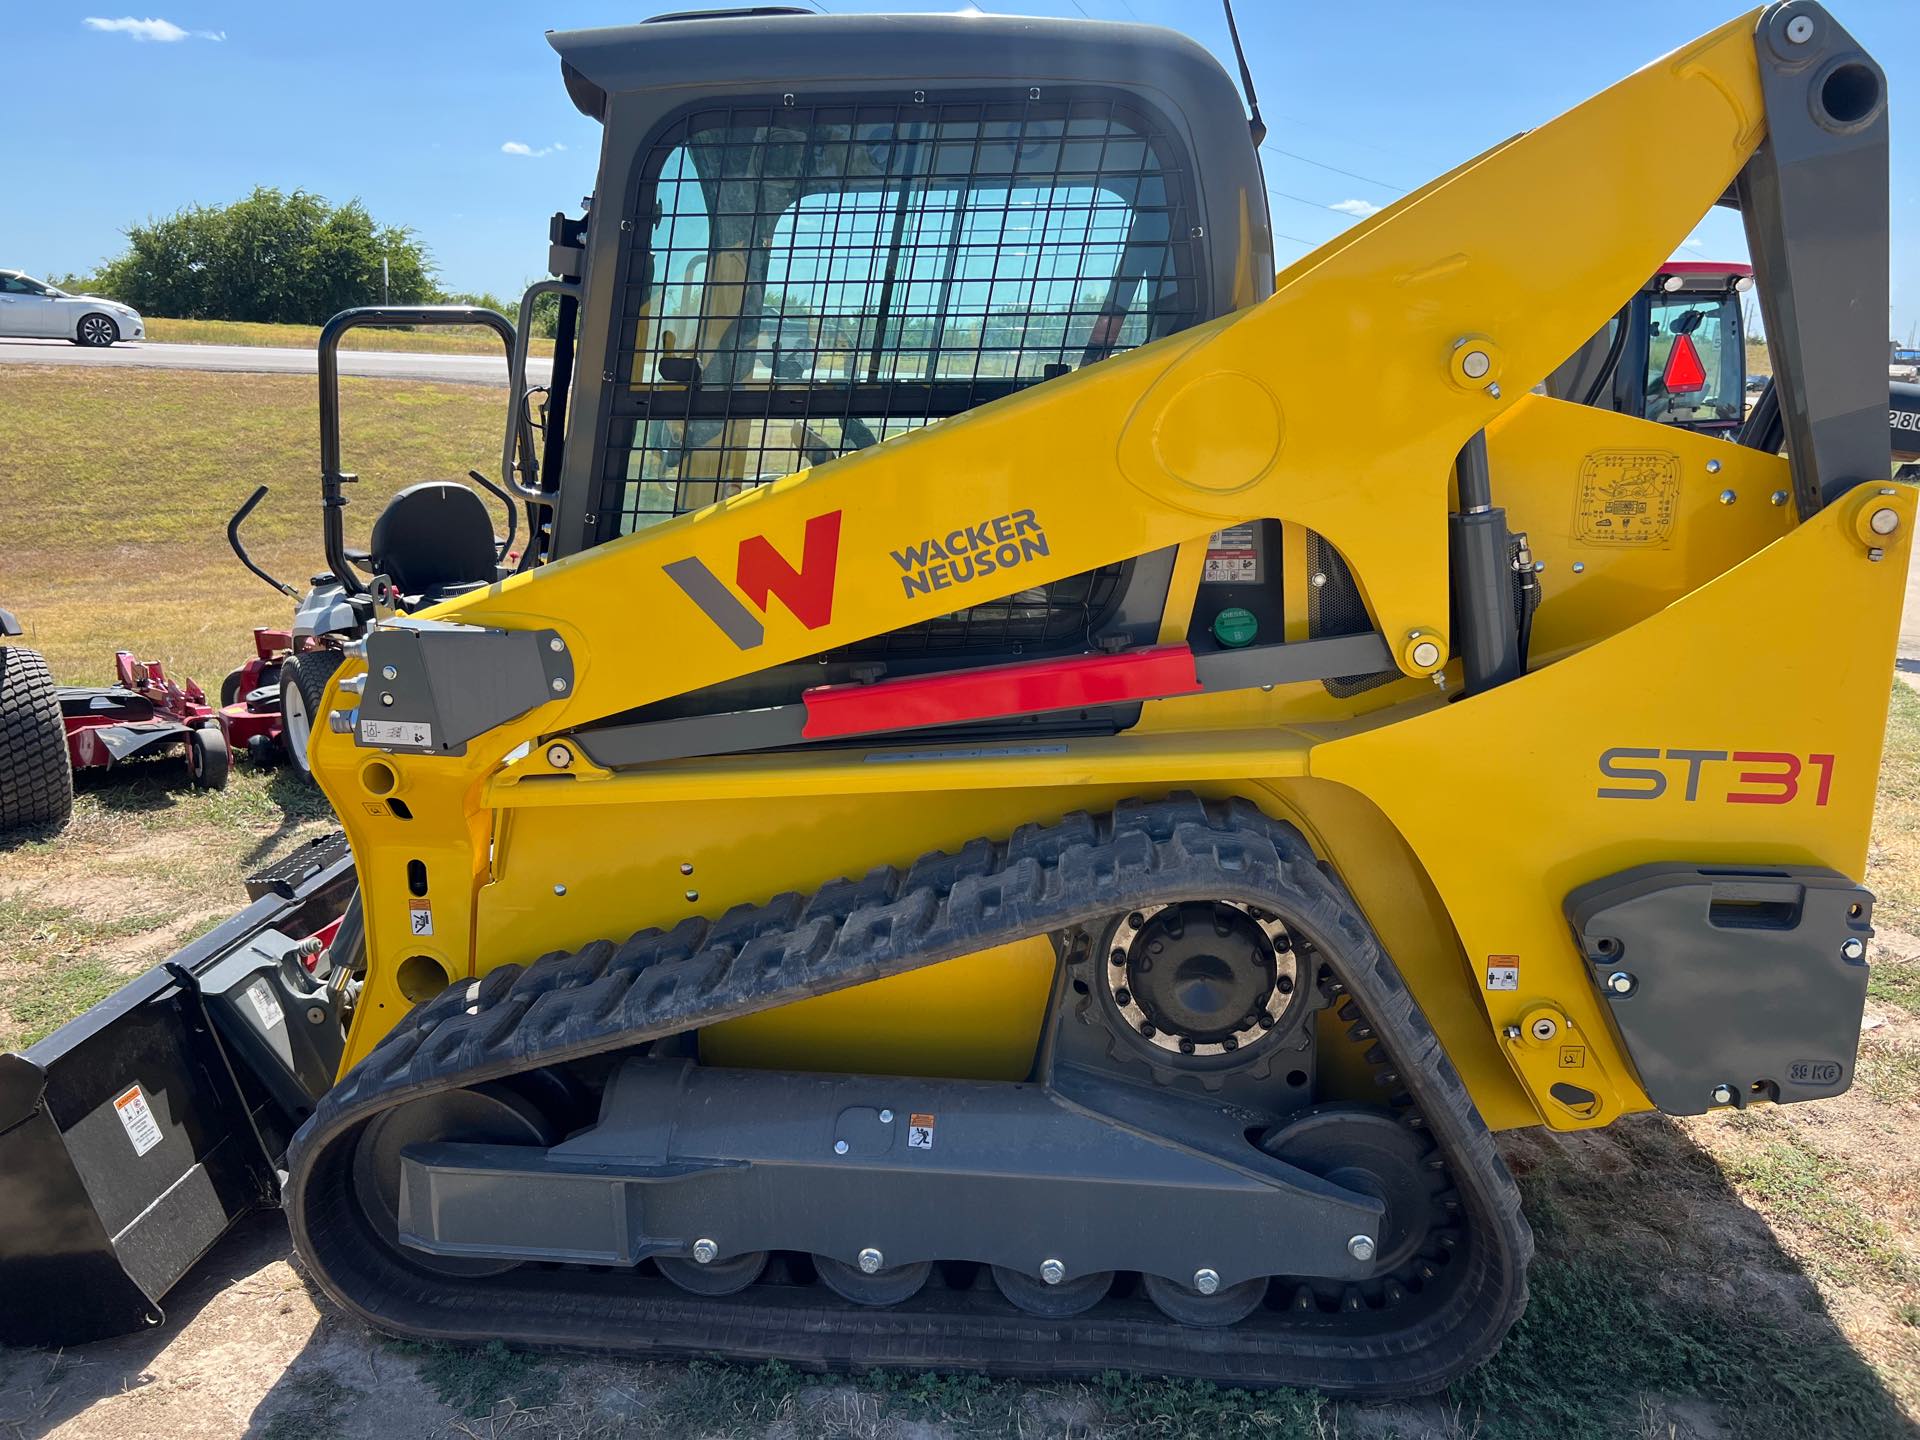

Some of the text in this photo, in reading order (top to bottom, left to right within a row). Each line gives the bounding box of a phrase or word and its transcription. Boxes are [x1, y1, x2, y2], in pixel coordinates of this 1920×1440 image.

[889, 508, 1042, 572] WACKER
[901, 529, 1050, 599] NEUSON
[1222, 609, 1249, 619] DIESEL
[1597, 747, 1835, 806] ST31
[1812, 1064, 1837, 1080] KG
